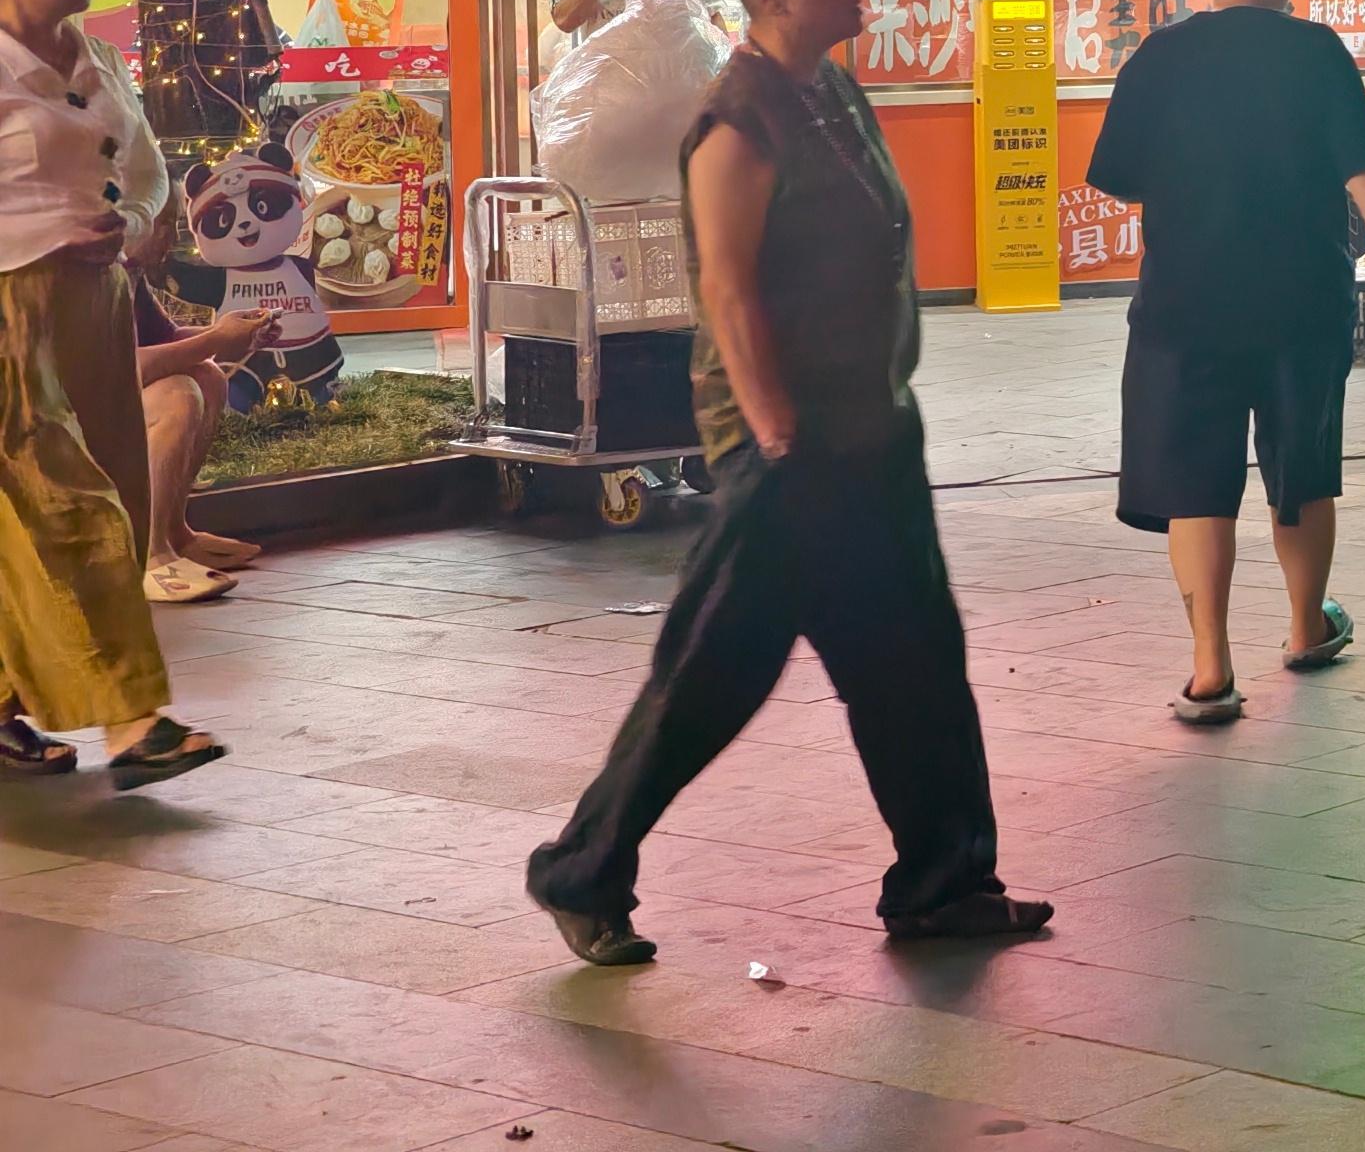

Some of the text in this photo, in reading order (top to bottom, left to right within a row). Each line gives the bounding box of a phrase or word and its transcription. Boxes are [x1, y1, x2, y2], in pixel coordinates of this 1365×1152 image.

[993, 138, 1047, 150] 美团标识
[995, 175, 1047, 190] 超级快充
[400, 168, 423, 270] 杜绝预制菜
[232, 281, 287, 298] PANDA
[259, 296, 314, 312] POWER
